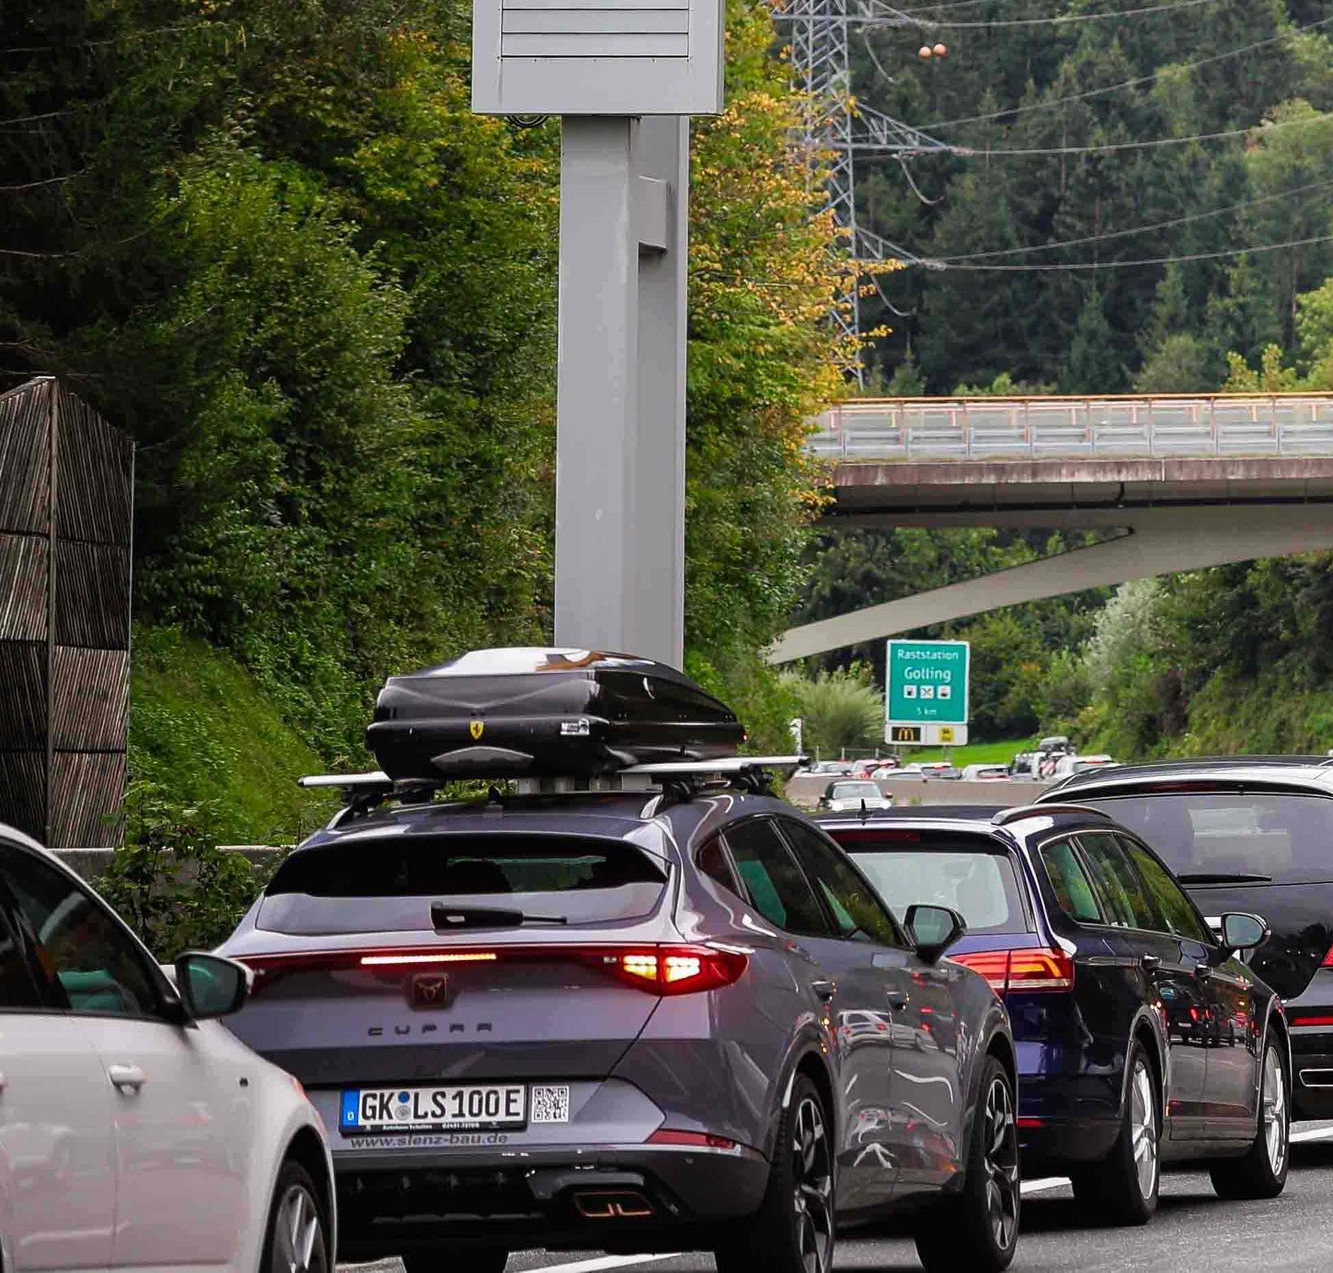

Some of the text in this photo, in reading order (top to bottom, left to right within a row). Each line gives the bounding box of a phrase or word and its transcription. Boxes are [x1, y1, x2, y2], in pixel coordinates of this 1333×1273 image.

[897, 648, 959, 661] Raststation
[903, 666, 952, 684] Golling
[361, 1091, 394, 1121] GK
